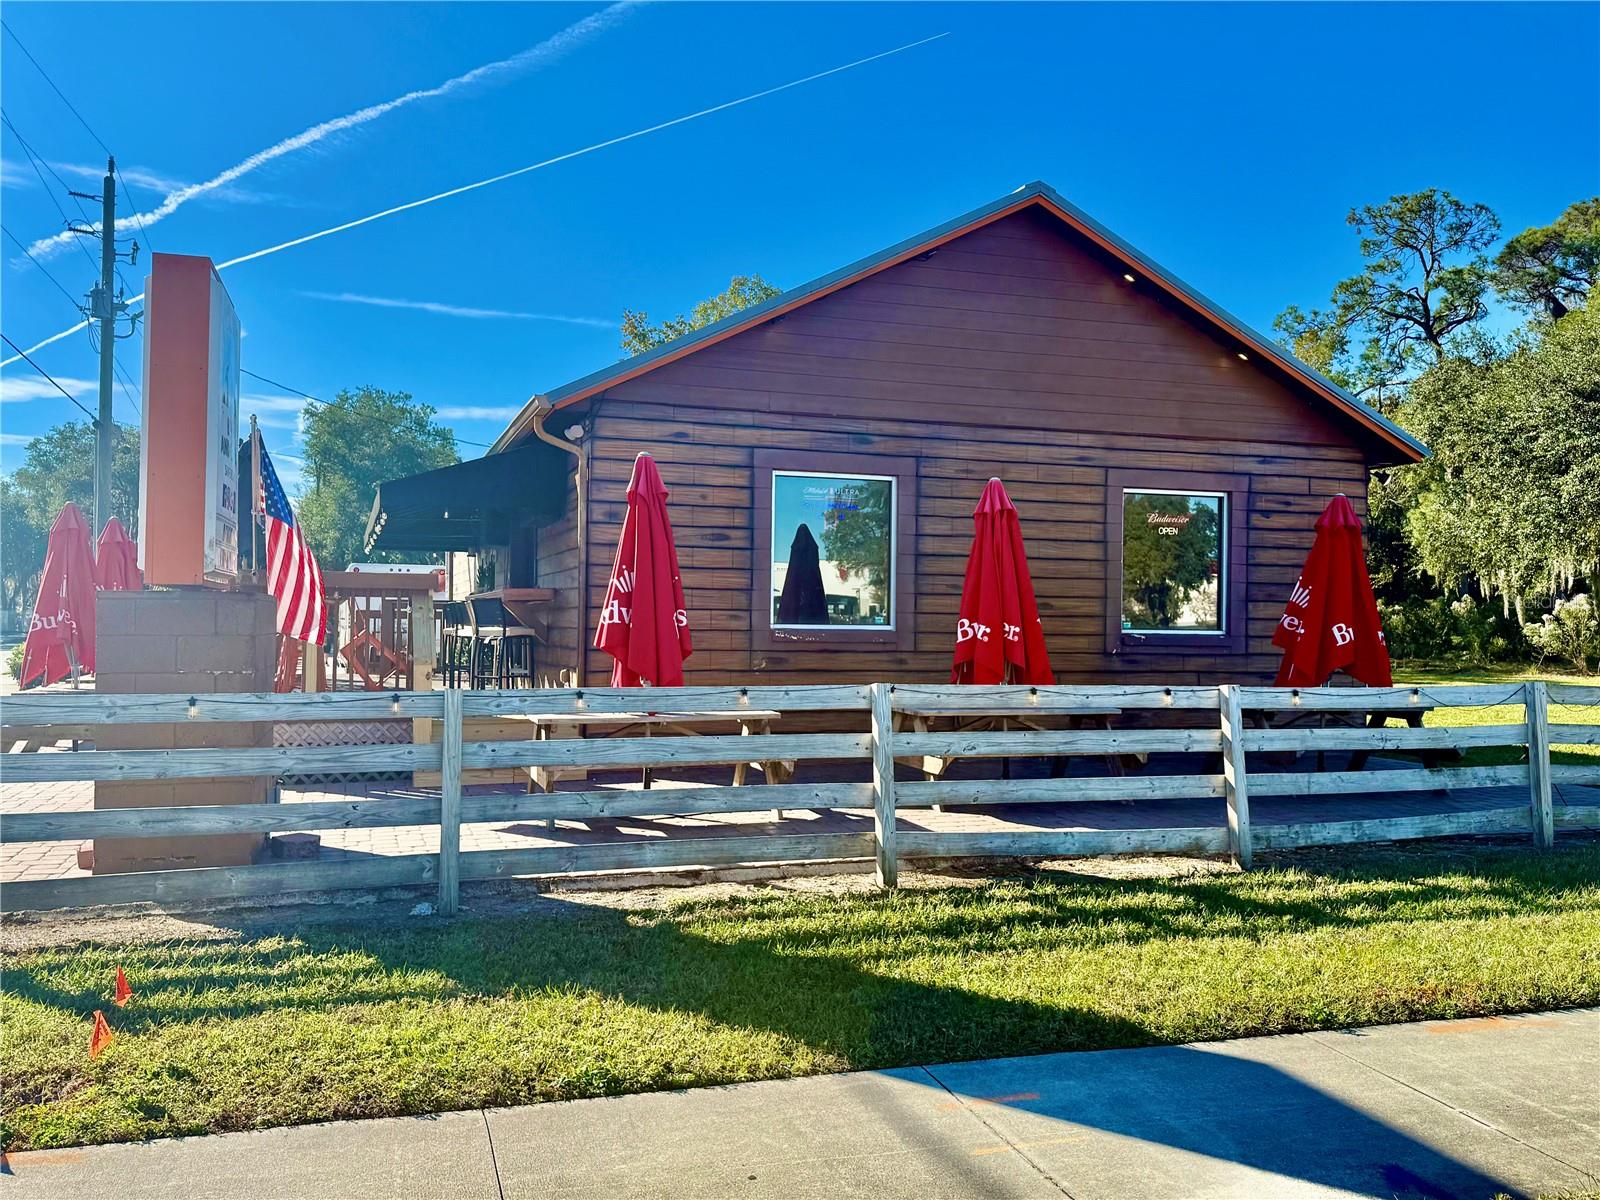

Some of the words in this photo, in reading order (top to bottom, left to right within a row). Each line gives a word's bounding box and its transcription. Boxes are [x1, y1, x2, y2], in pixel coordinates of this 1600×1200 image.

[834, 488, 861, 496] ULTRA
[1146, 512, 1190, 523] Budweiser
[1158, 526, 1179, 536] OPEN
